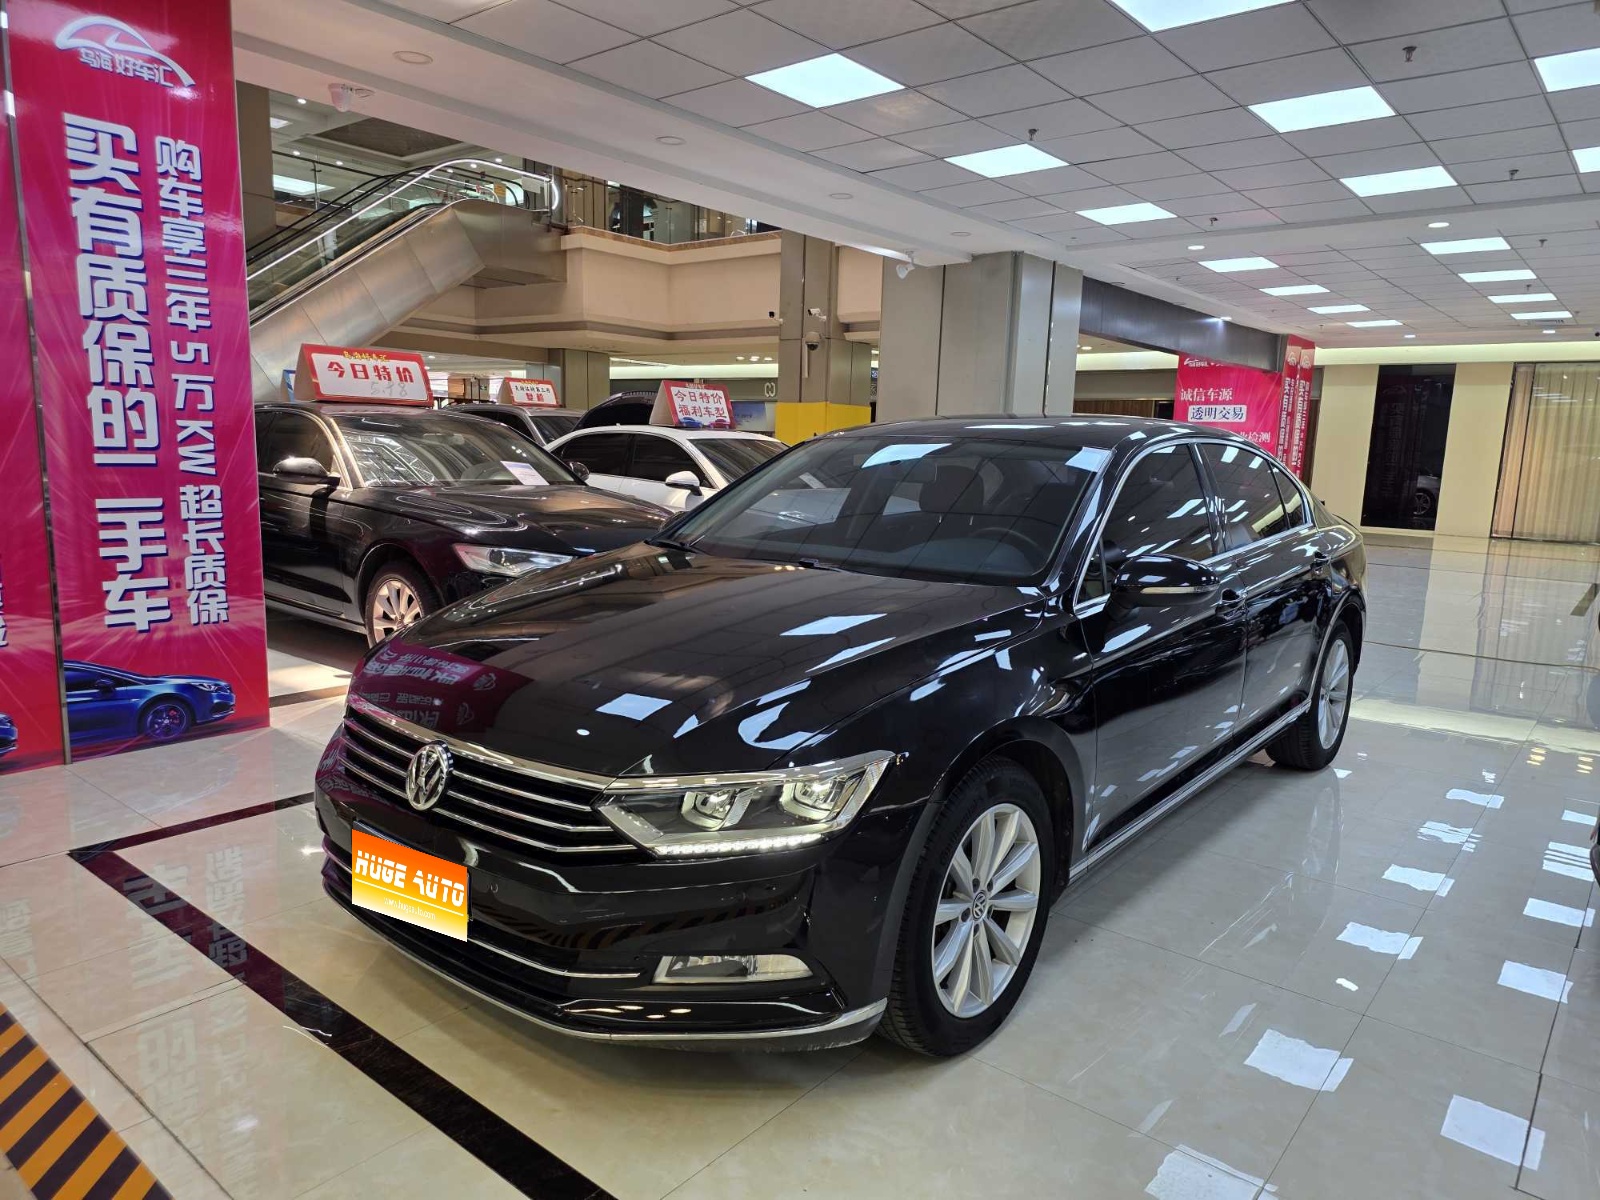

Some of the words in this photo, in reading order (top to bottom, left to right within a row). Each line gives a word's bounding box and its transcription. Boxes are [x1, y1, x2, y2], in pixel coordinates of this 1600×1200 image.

[62, 112, 172, 632] 买有质保的二手车
[327, 361, 414, 383] 今日特价
[675, 390, 723, 404] 今日特价
[1180, 387, 1233, 402] 诚信车源
[678, 404, 727, 418] 福利车型
[1190, 406, 1244, 420] 透明交易
